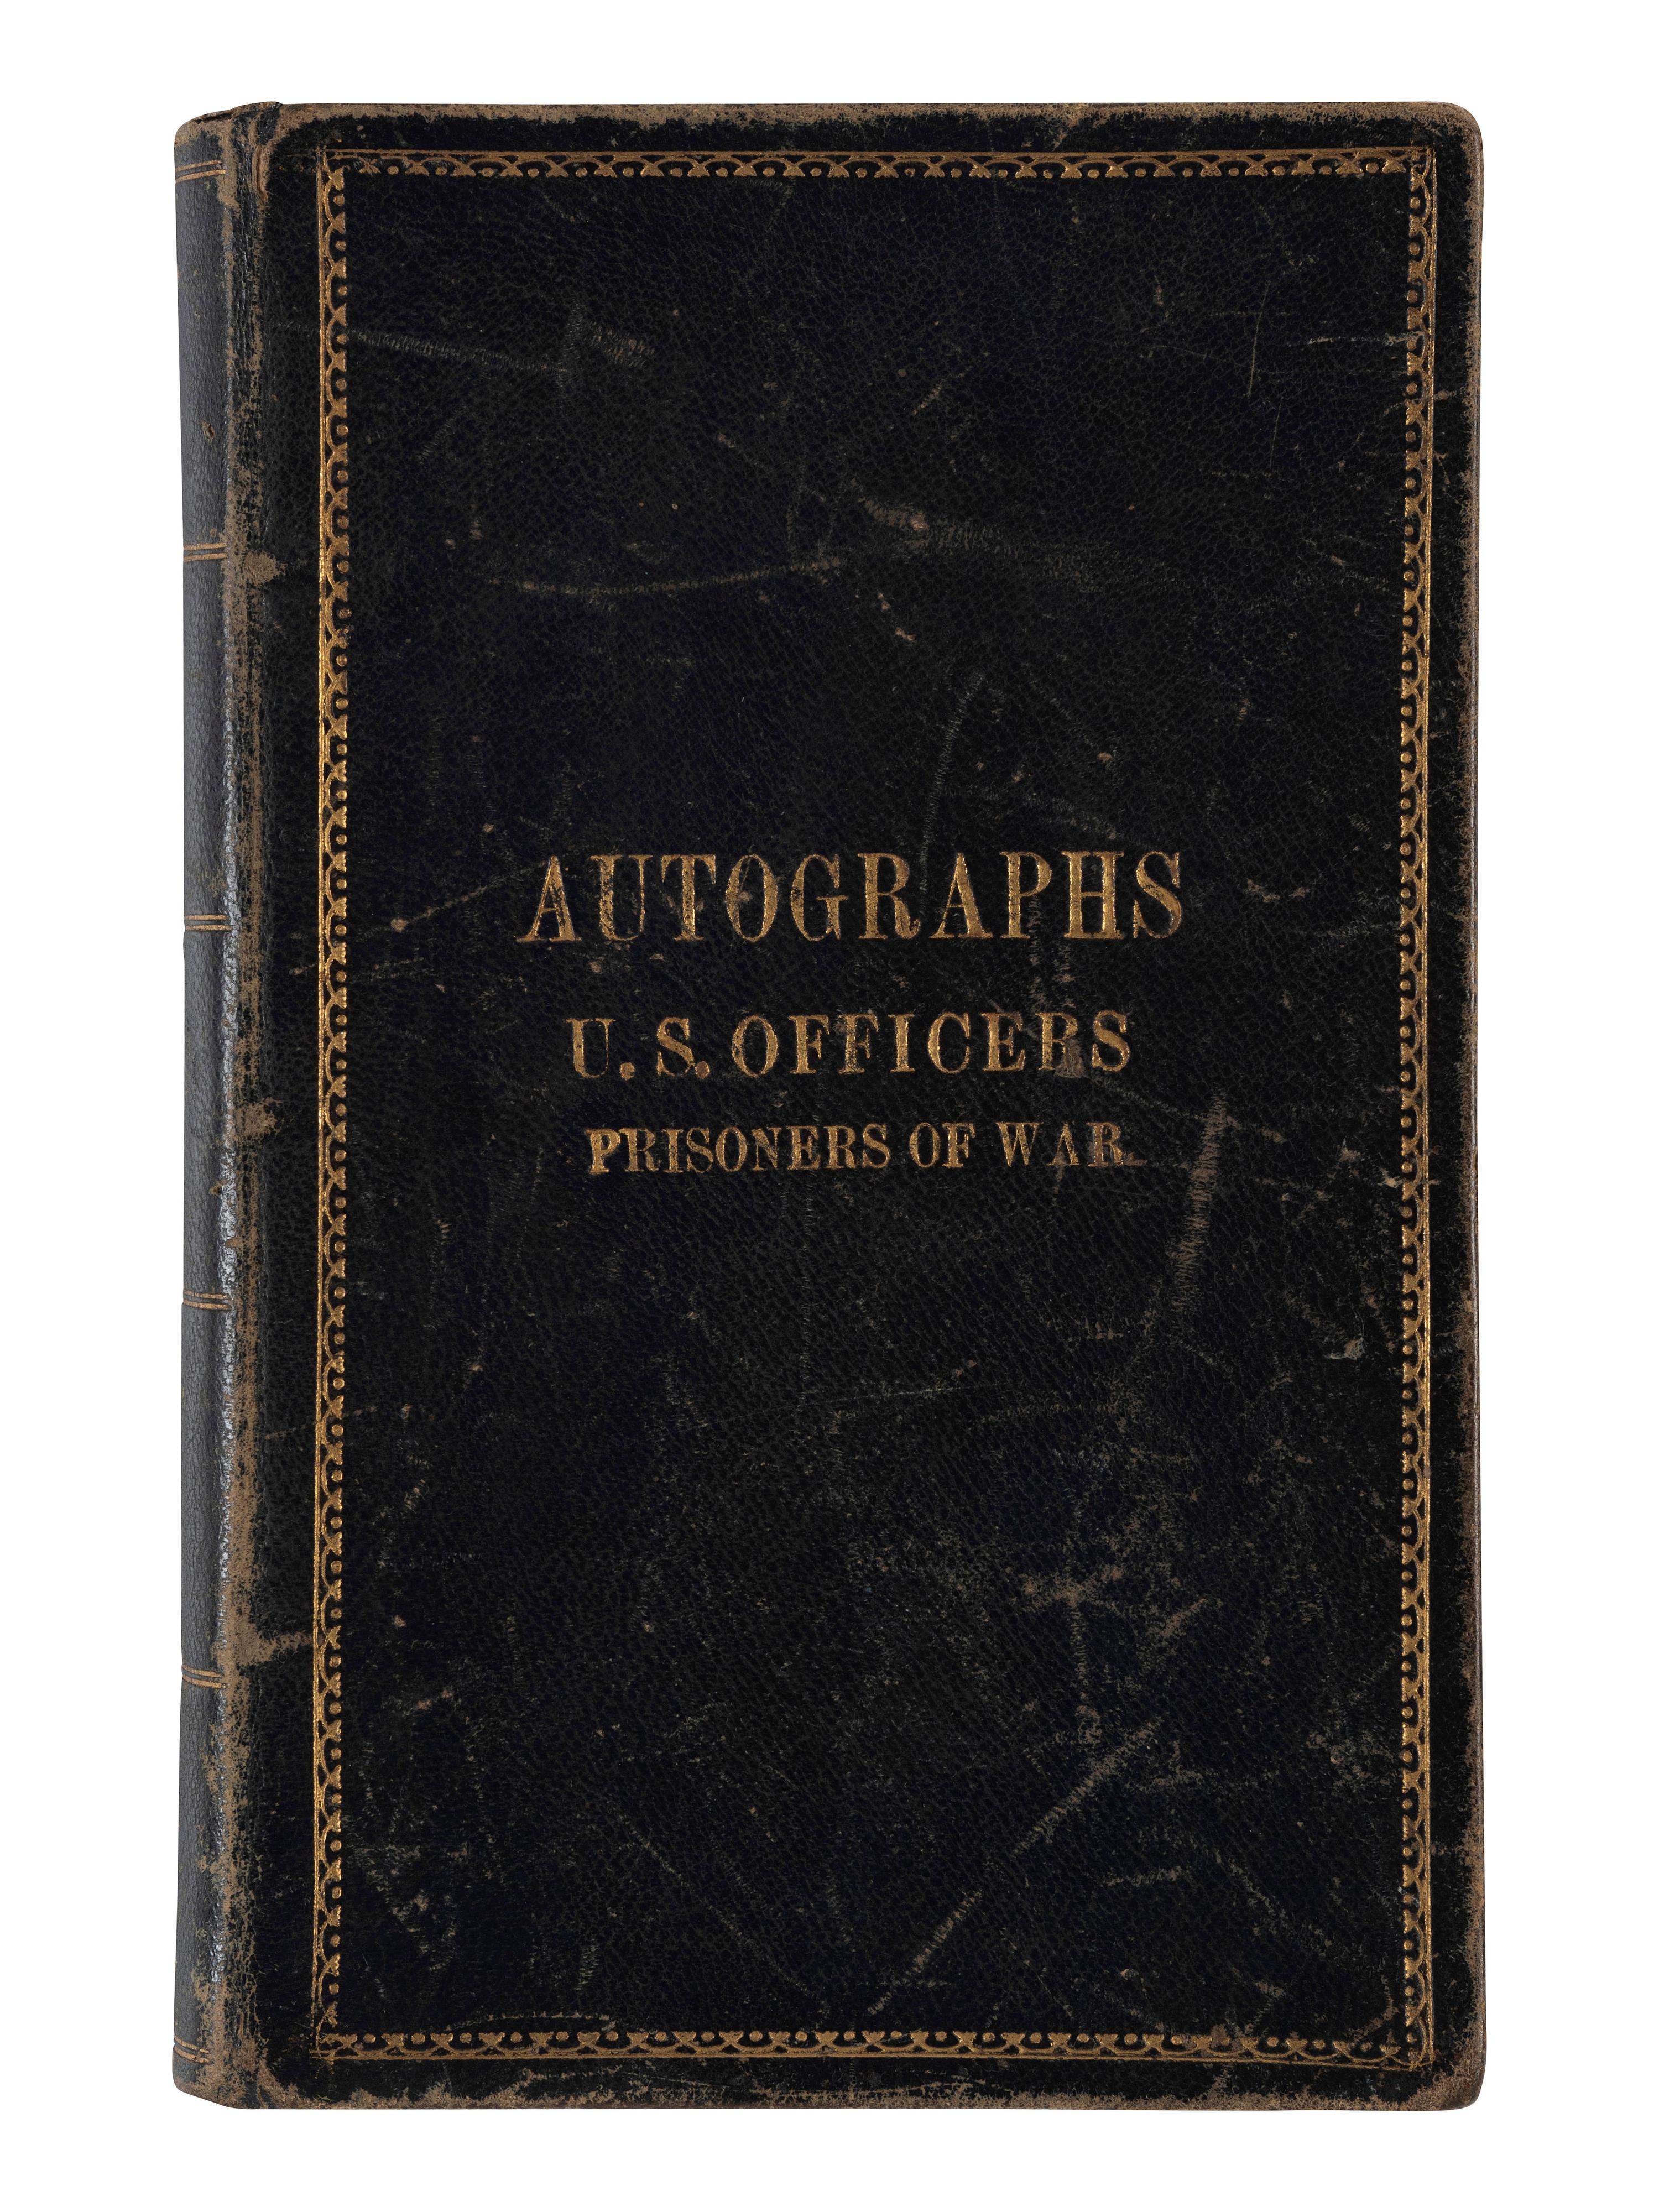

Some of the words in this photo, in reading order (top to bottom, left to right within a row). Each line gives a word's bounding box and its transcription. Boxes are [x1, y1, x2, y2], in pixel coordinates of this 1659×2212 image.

[516, 850, 1183, 943] AUTOGRAPHS
[731, 1010, 1131, 1078] OFFICERS
[586, 1124, 891, 1174] PRISONERS
[909, 1121, 975, 1168] OF
[995, 1121, 1125, 1167] WAR
